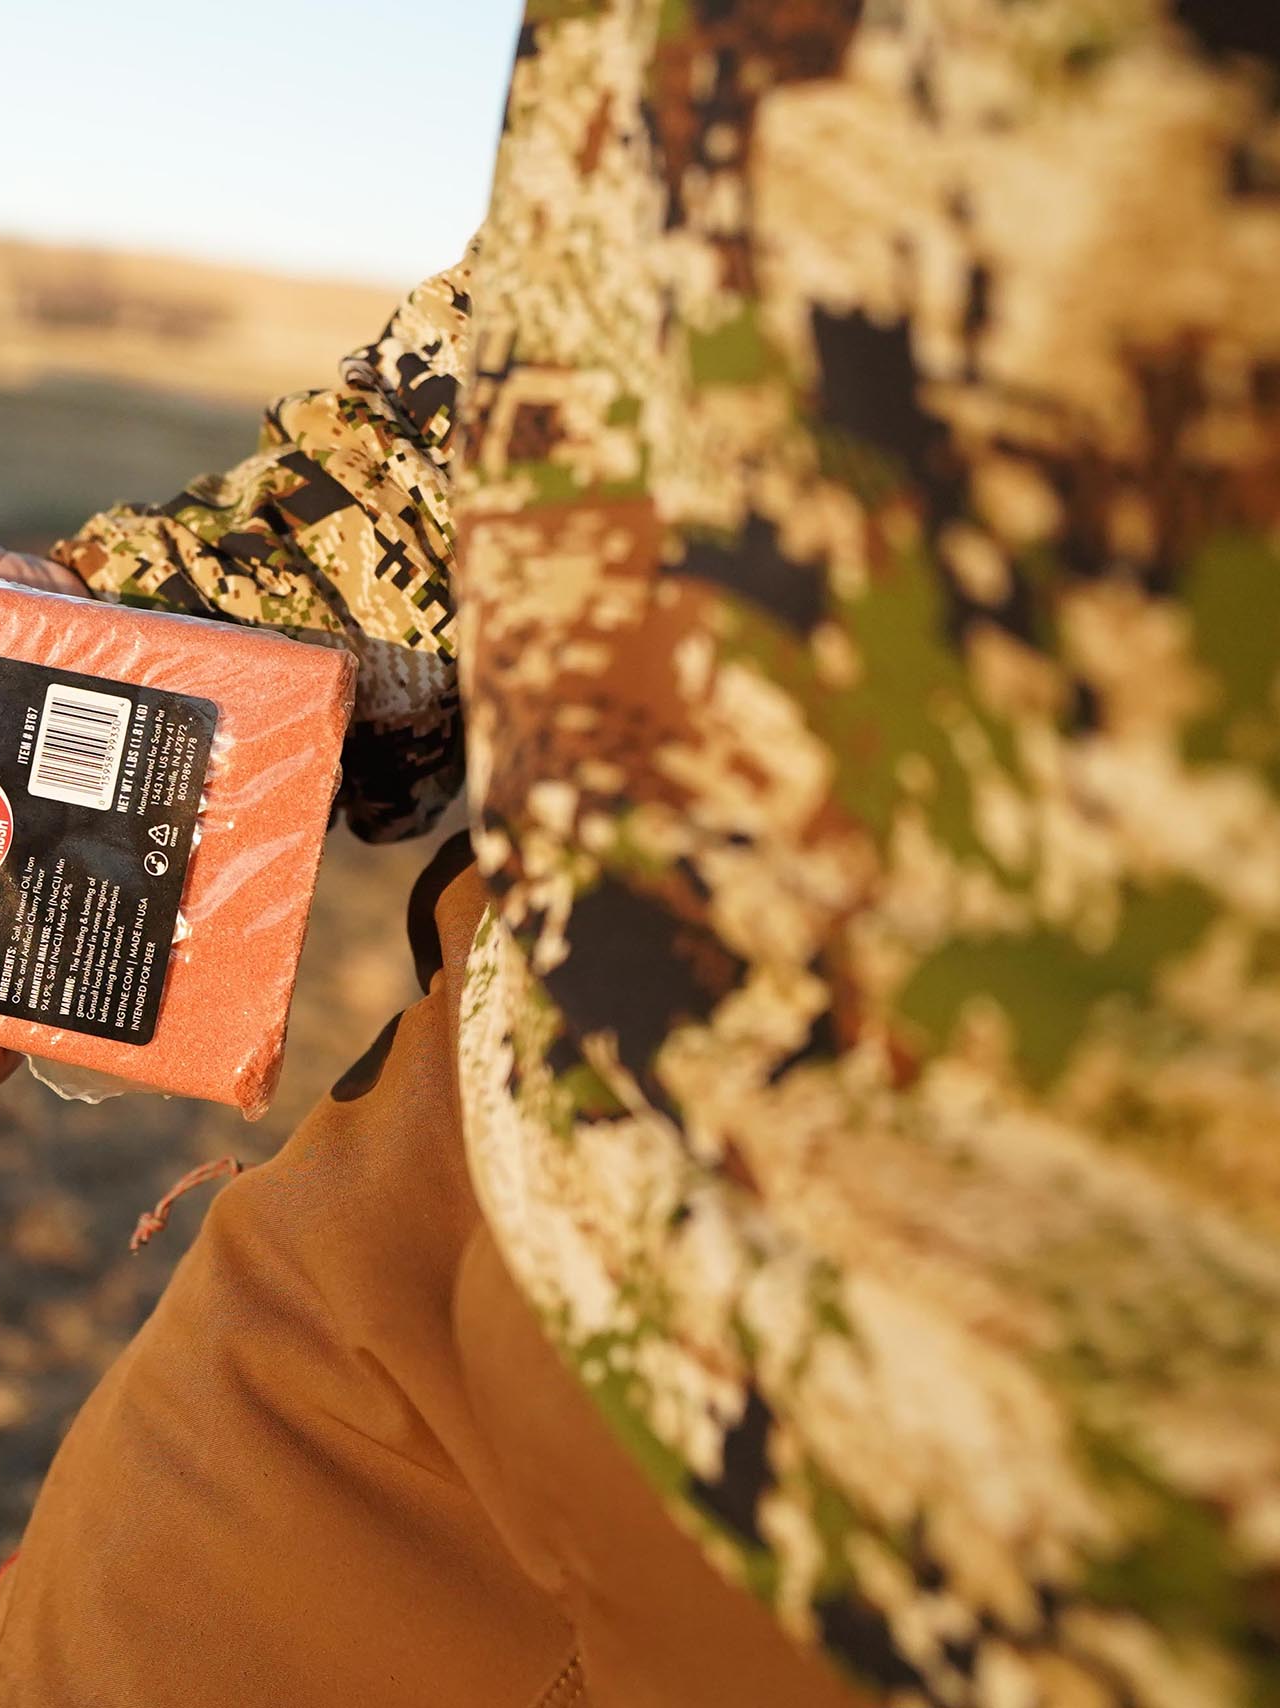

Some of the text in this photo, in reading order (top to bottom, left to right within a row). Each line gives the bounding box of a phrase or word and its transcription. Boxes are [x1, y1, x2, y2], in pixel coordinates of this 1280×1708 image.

[17, 706, 38, 765] ITEM # BT67
[116, 704, 149, 813] NET WT 4 LBS (1.81 KG)
[136, 709, 165, 816] Manufactured for Scott Pet
[150, 722, 175, 805] 1543 N. US Hwy 41
[163, 724, 188, 807] Rockville, IN 47872
[177, 737, 198, 801] 800.989.4178
[169, 826, 179, 847] OTHER
[24, 856, 35, 873] Iron
[55, 858, 66, 875] Min
[20, 875, 33, 890] Oil,
[59, 883, 73, 911] 99.9%
[97, 878, 110, 911] regions.
[15, 890, 28, 923] Mineral
[44, 907, 56, 924] Salt
[136, 897, 149, 917] USA
[10, 924, 23, 942] Salt,
[11, 868, 45, 1004] Oxide, and Artificial Cherry Flavor
[56, 912, 67, 932] Max
[92, 911, 103, 934] some
[134, 917, 144, 930] IN
[37, 924, 52, 963] ANALYSIS:
[59, 876, 97, 1015] WARNING: The feeding & baiting of
[88, 934, 98, 943] in
[102, 930, 111, 948] and
[129, 930, 142, 959] MADE
[46, 964, 57, 981] Salt
[82, 943, 96, 986] prohibited
[95, 949, 108, 968] laws
[28, 962, 45, 1009] GUARANTEED
[91, 968, 104, 990] local
[97, 925, 125, 1023] before using this product.
[131, 941, 156, 1031] INTENDED FOR DEER
[40, 982, 55, 1011] 94.9%,
[76, 994, 86, 1018] game
[86, 989, 99, 1020] Consult
[115, 967, 135, 1028] BIGTINE.COM
